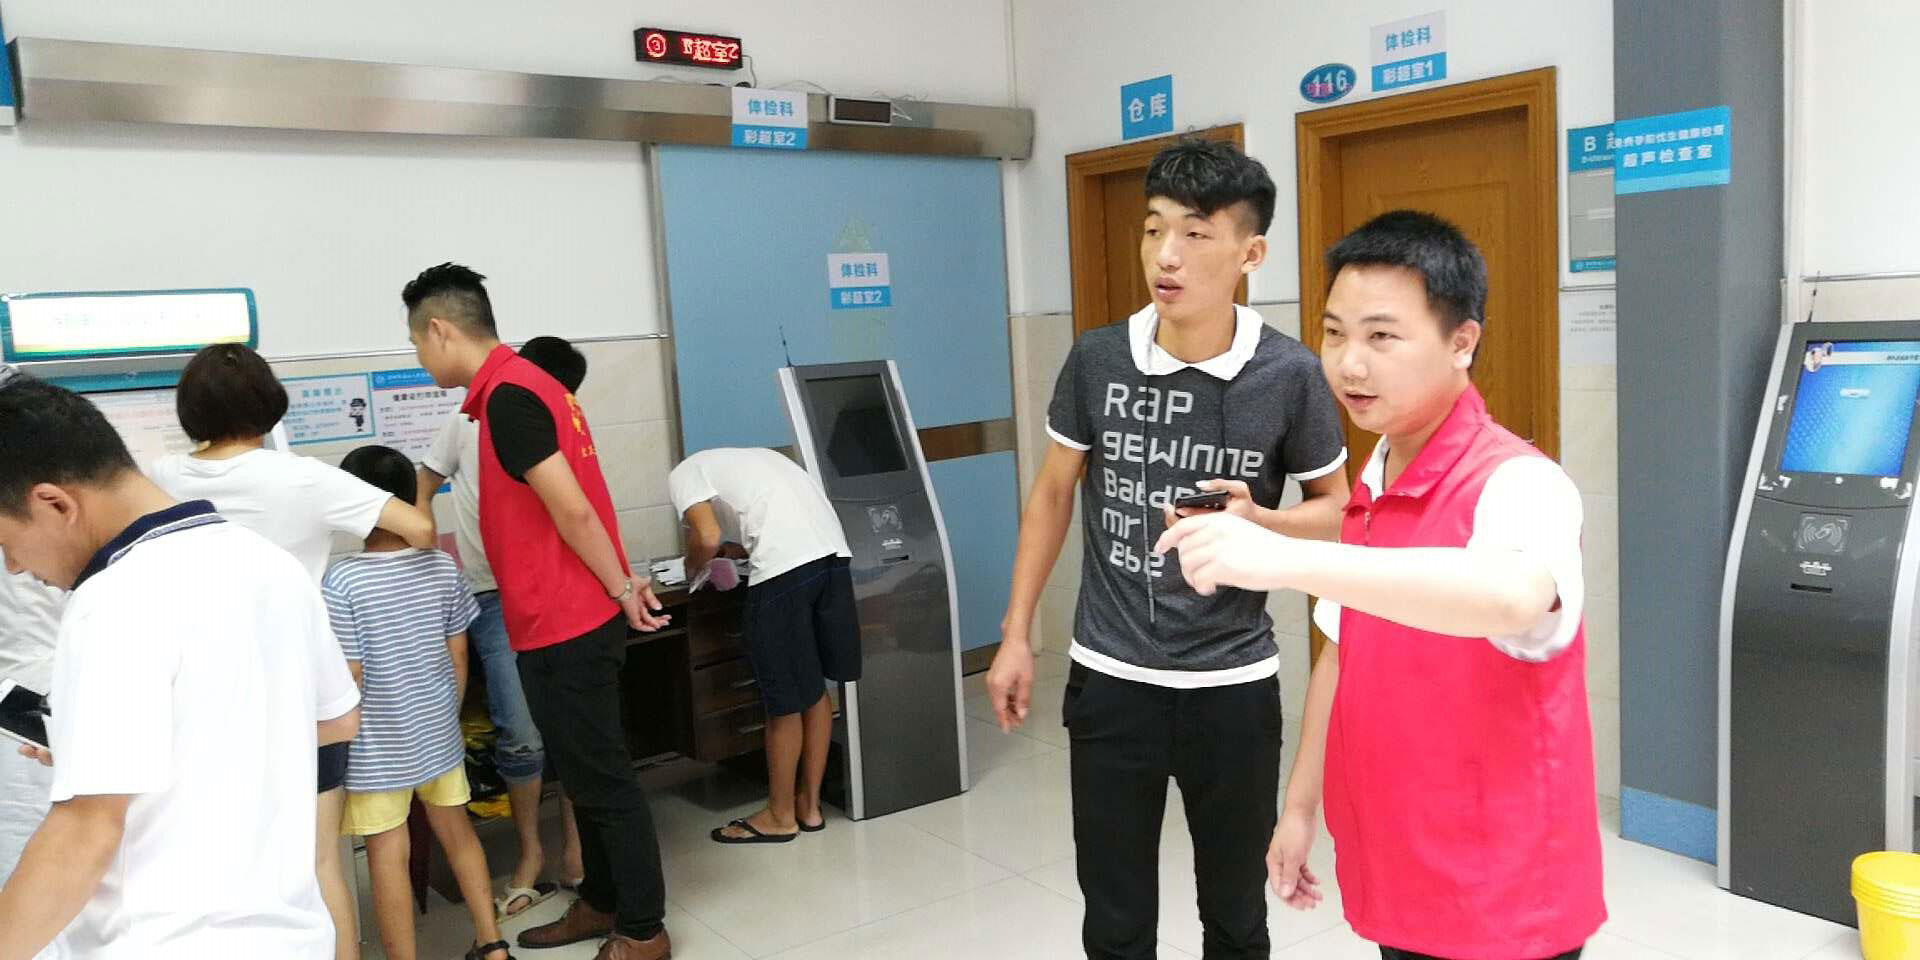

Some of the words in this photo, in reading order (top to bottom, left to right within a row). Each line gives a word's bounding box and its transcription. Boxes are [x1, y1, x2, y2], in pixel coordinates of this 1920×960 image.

[1385, 25, 1431, 51] 体检科
[1311, 69, 1348, 98] 116
[1382, 59, 1434, 84] 彩超室1
[747, 99, 793, 117] 体检科
[1127, 92, 1168, 123] 仓库
[743, 129, 796, 146] 彩超室2
[1623, 144, 1713, 168] 超声检查室
[841, 262, 878, 278] 体检科
[840, 290, 882, 305] 彩超室2
[1102, 507, 1142, 539] mr
